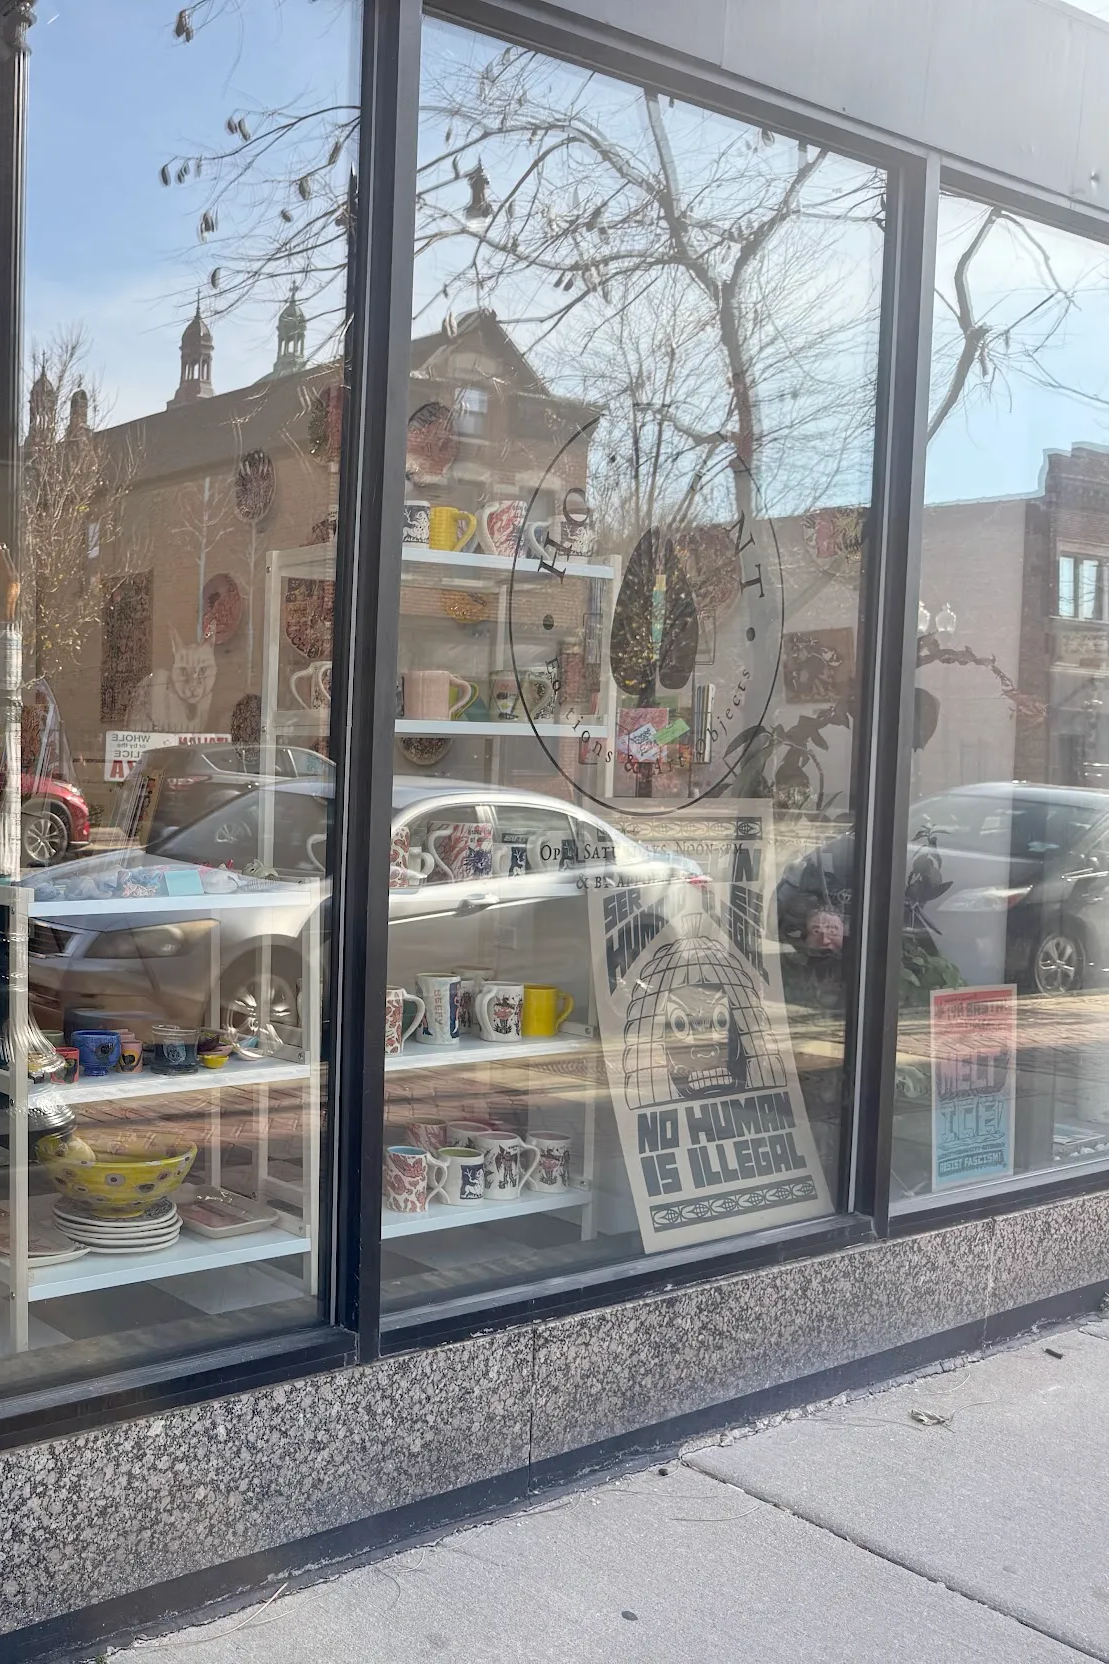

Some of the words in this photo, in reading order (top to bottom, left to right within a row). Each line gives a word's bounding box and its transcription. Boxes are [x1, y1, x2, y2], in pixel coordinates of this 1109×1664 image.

[623, 750, 641, 774] &
[649, 754, 685, 776] Art
[575, 873, 589, 889] &
[603, 888, 643, 937] SER
[637, 1108, 680, 1154] NO
[686, 1091, 796, 1146] HUMAN
[640, 1152, 683, 1197] IS
[687, 1131, 807, 1190] ILLEGAL
